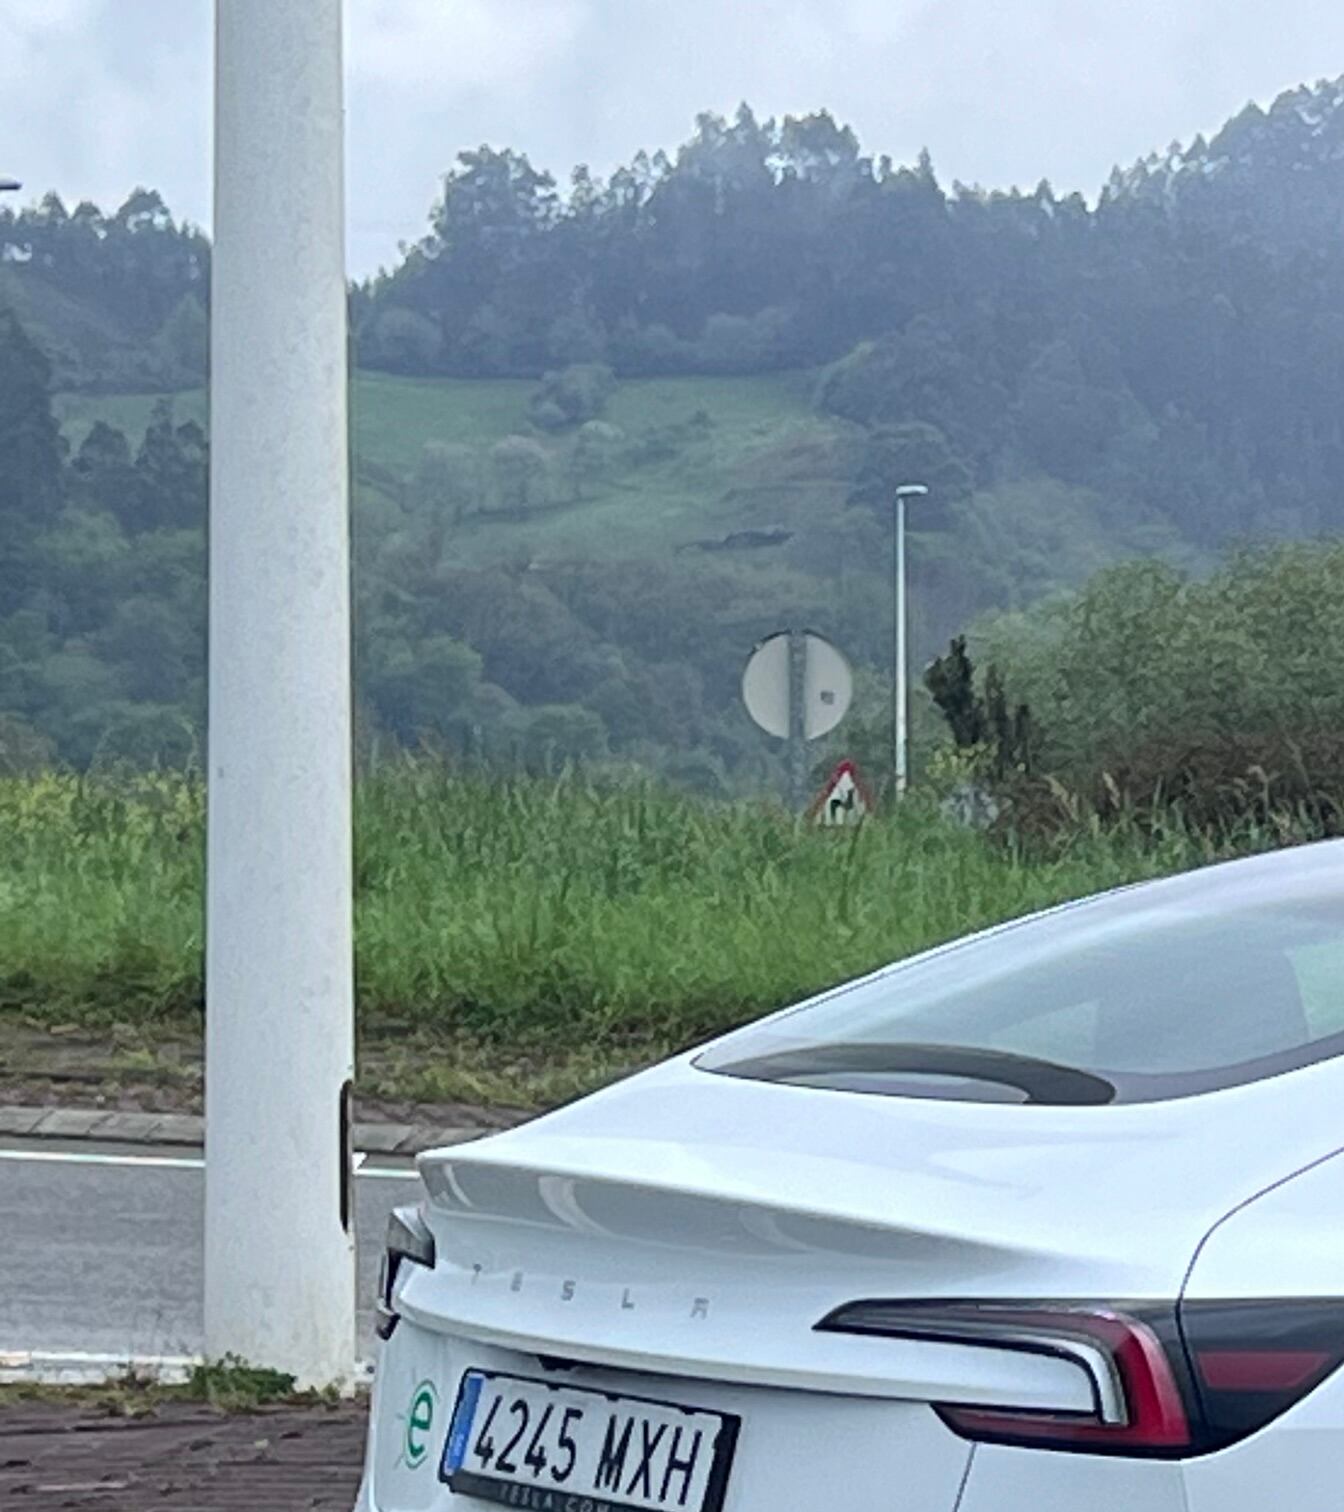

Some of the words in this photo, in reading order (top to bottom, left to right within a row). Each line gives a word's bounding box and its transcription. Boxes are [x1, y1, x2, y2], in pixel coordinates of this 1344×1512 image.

[471, 1262, 710, 1320] TESLA
[473, 1395, 584, 1482] 4245
[593, 1414, 703, 1506] MXH
